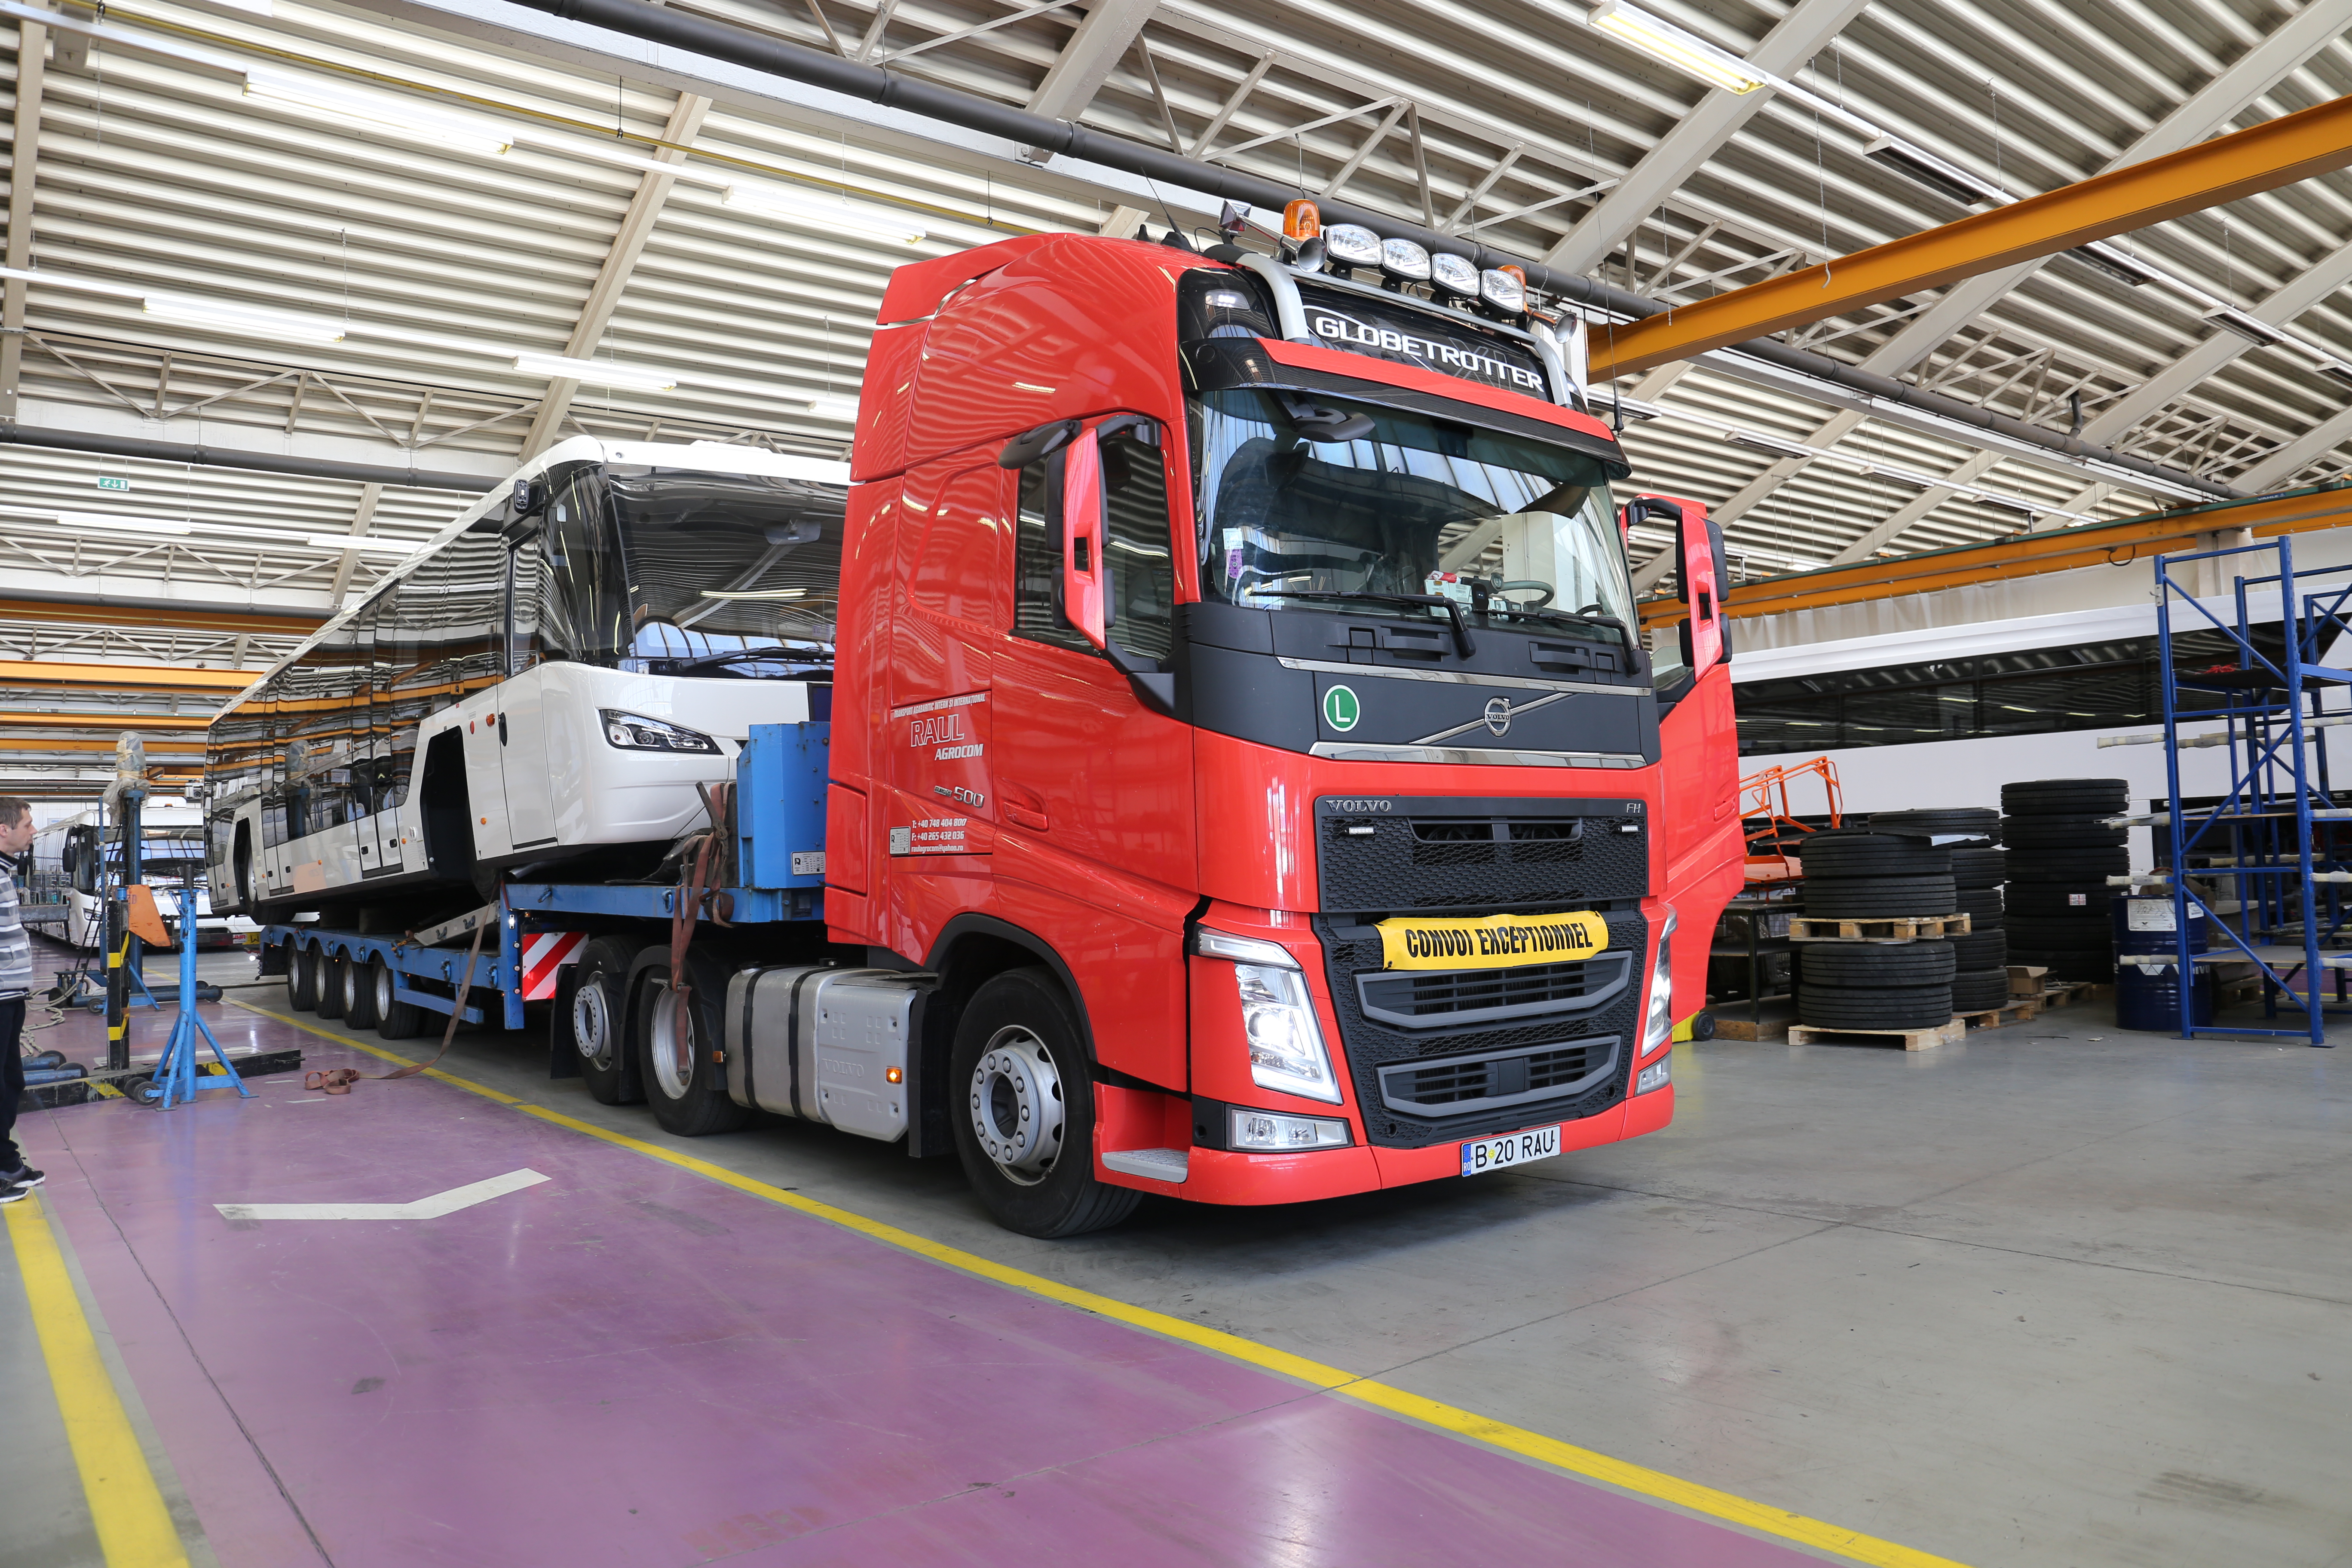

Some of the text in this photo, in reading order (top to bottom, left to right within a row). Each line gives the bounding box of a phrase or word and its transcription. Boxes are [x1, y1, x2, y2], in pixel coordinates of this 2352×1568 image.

[1315, 316, 1545, 392] GLOBETROTTER
[894, 707, 913, 718] TRANSPORT
[913, 702, 934, 714] AGABARITIC
[934, 700, 949, 710] INTERN
[954, 693, 986, 706] INTERNAȚIONAL
[1335, 694, 1351, 722] L
[911, 714, 965, 747] RAUL
[934, 744, 984, 760] AGROCOM
[953, 786, 985, 808] 500
[1326, 800, 1392, 812] VOLVO
[1626, 803, 1641, 813] FH
[912, 818, 967, 828] T: +40 748 404 800
[912, 833, 916, 841] F:
[917, 832, 928, 841] +40
[928, 832, 939, 840] 265
[940, 831, 952, 840] 432
[952, 830, 965, 839] 036
[911, 844, 963, 854] raulagrocom@yahoo.ro
[1405, 922, 1593, 958] CONVOI EXCEPTIONNEL
[821, 1058, 864, 1078] VOLVO
[1464, 1130, 1553, 1172] RO B 20 RAU
